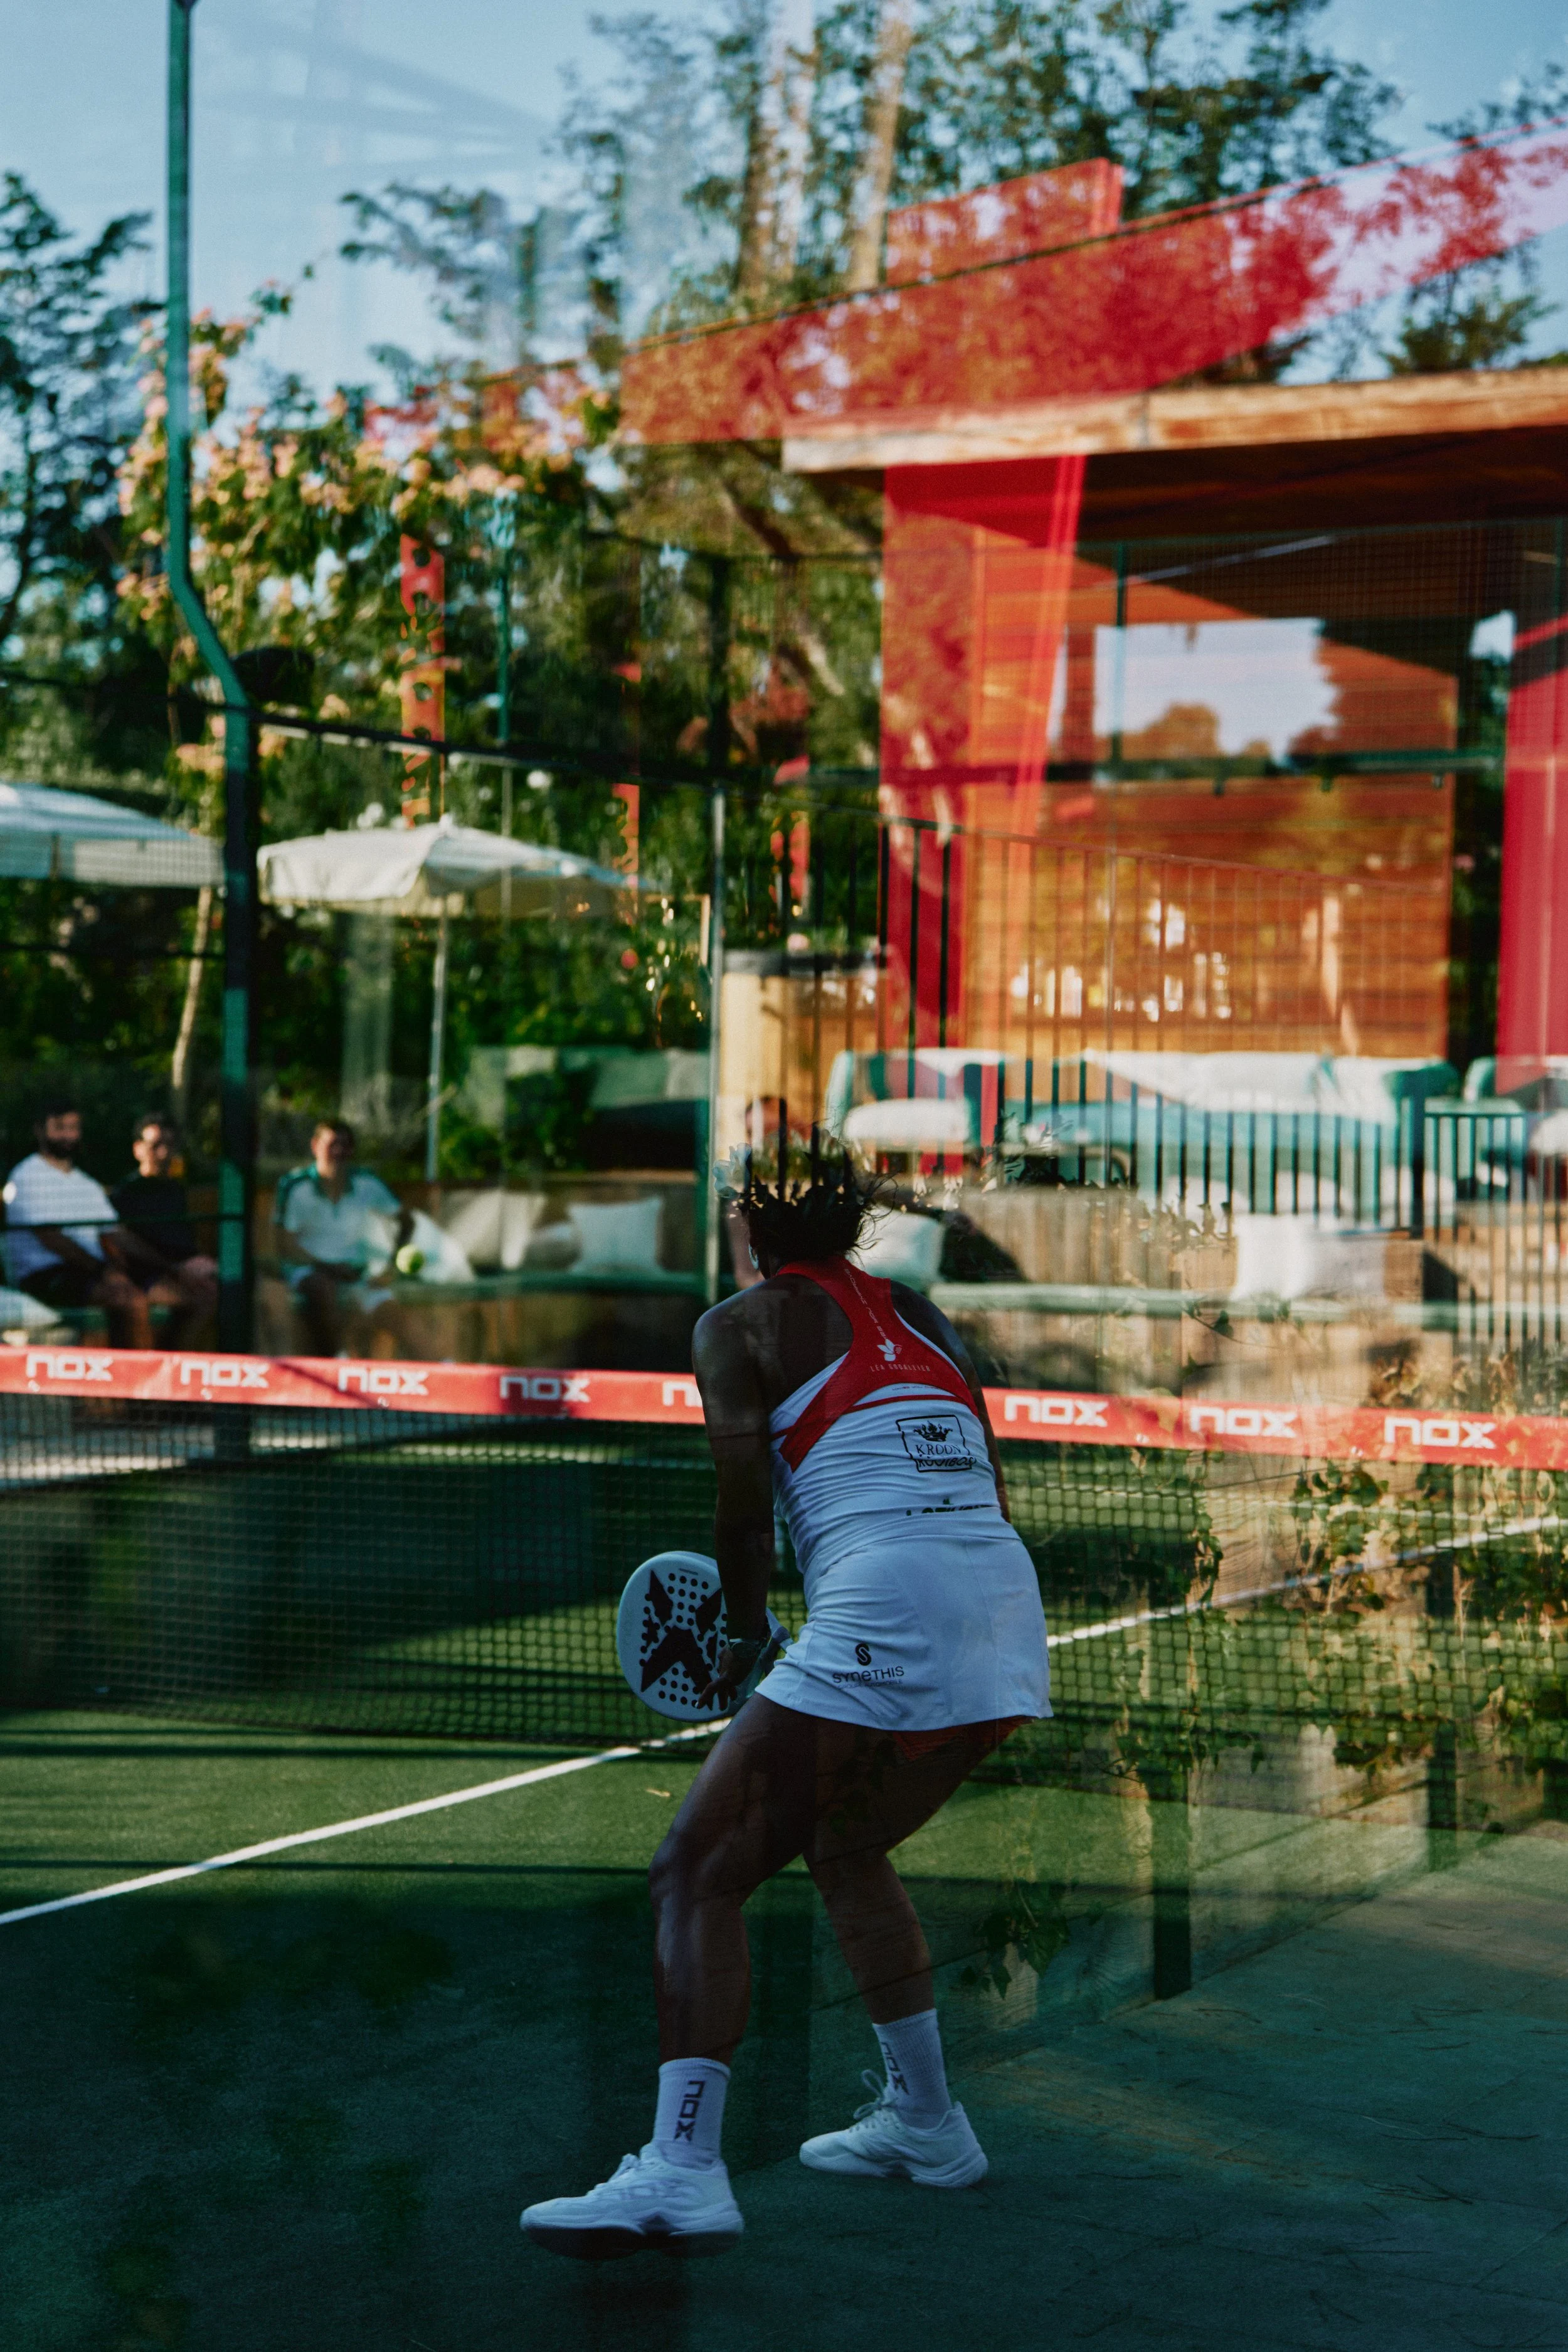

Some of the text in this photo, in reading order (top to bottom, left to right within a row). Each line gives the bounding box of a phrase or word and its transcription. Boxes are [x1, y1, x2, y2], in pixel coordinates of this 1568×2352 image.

[26, 1353, 114, 1380] nox
[181, 1359, 269, 1387] nox
[338, 1367, 428, 1396] nox
[500, 1376, 590, 1402] nox
[1005, 1396, 1108, 1427] nox
[1190, 1407, 1296, 1438] nox
[1384, 1417, 1496, 1449] nox
[915, 1444, 961, 1455] KROON
[674, 2080, 706, 2142] nox
